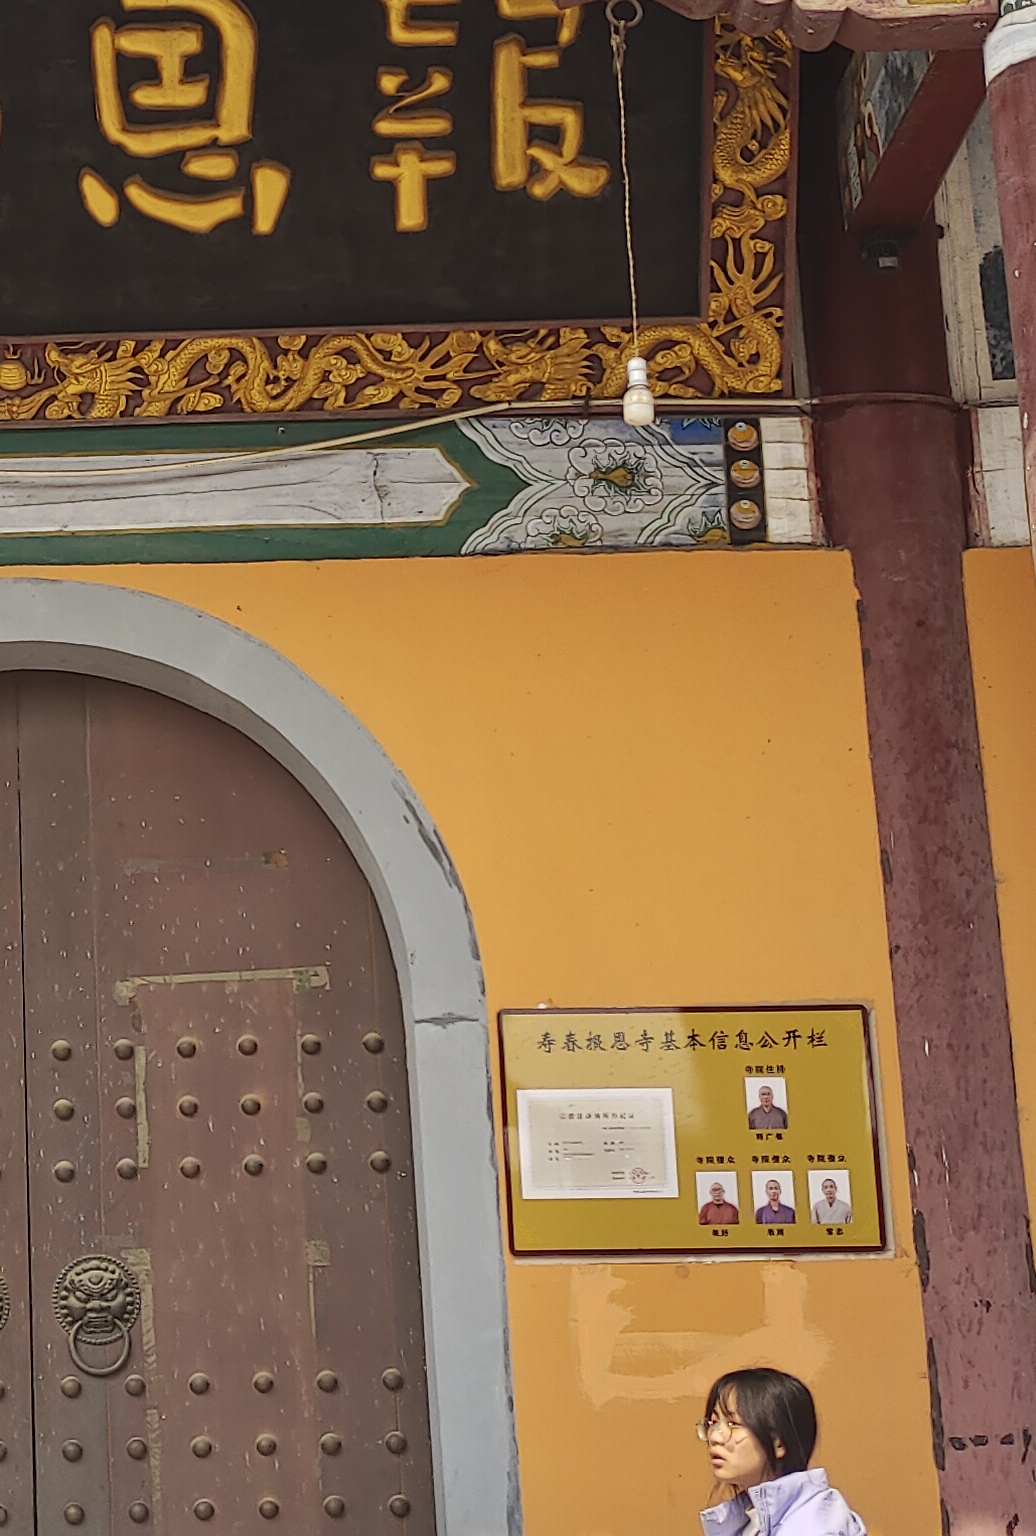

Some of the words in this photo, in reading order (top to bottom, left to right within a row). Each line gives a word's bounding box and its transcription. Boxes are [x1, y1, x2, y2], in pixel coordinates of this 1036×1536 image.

[536, 1029, 828, 1054] 寿春报恩寺基本信息公开栏
